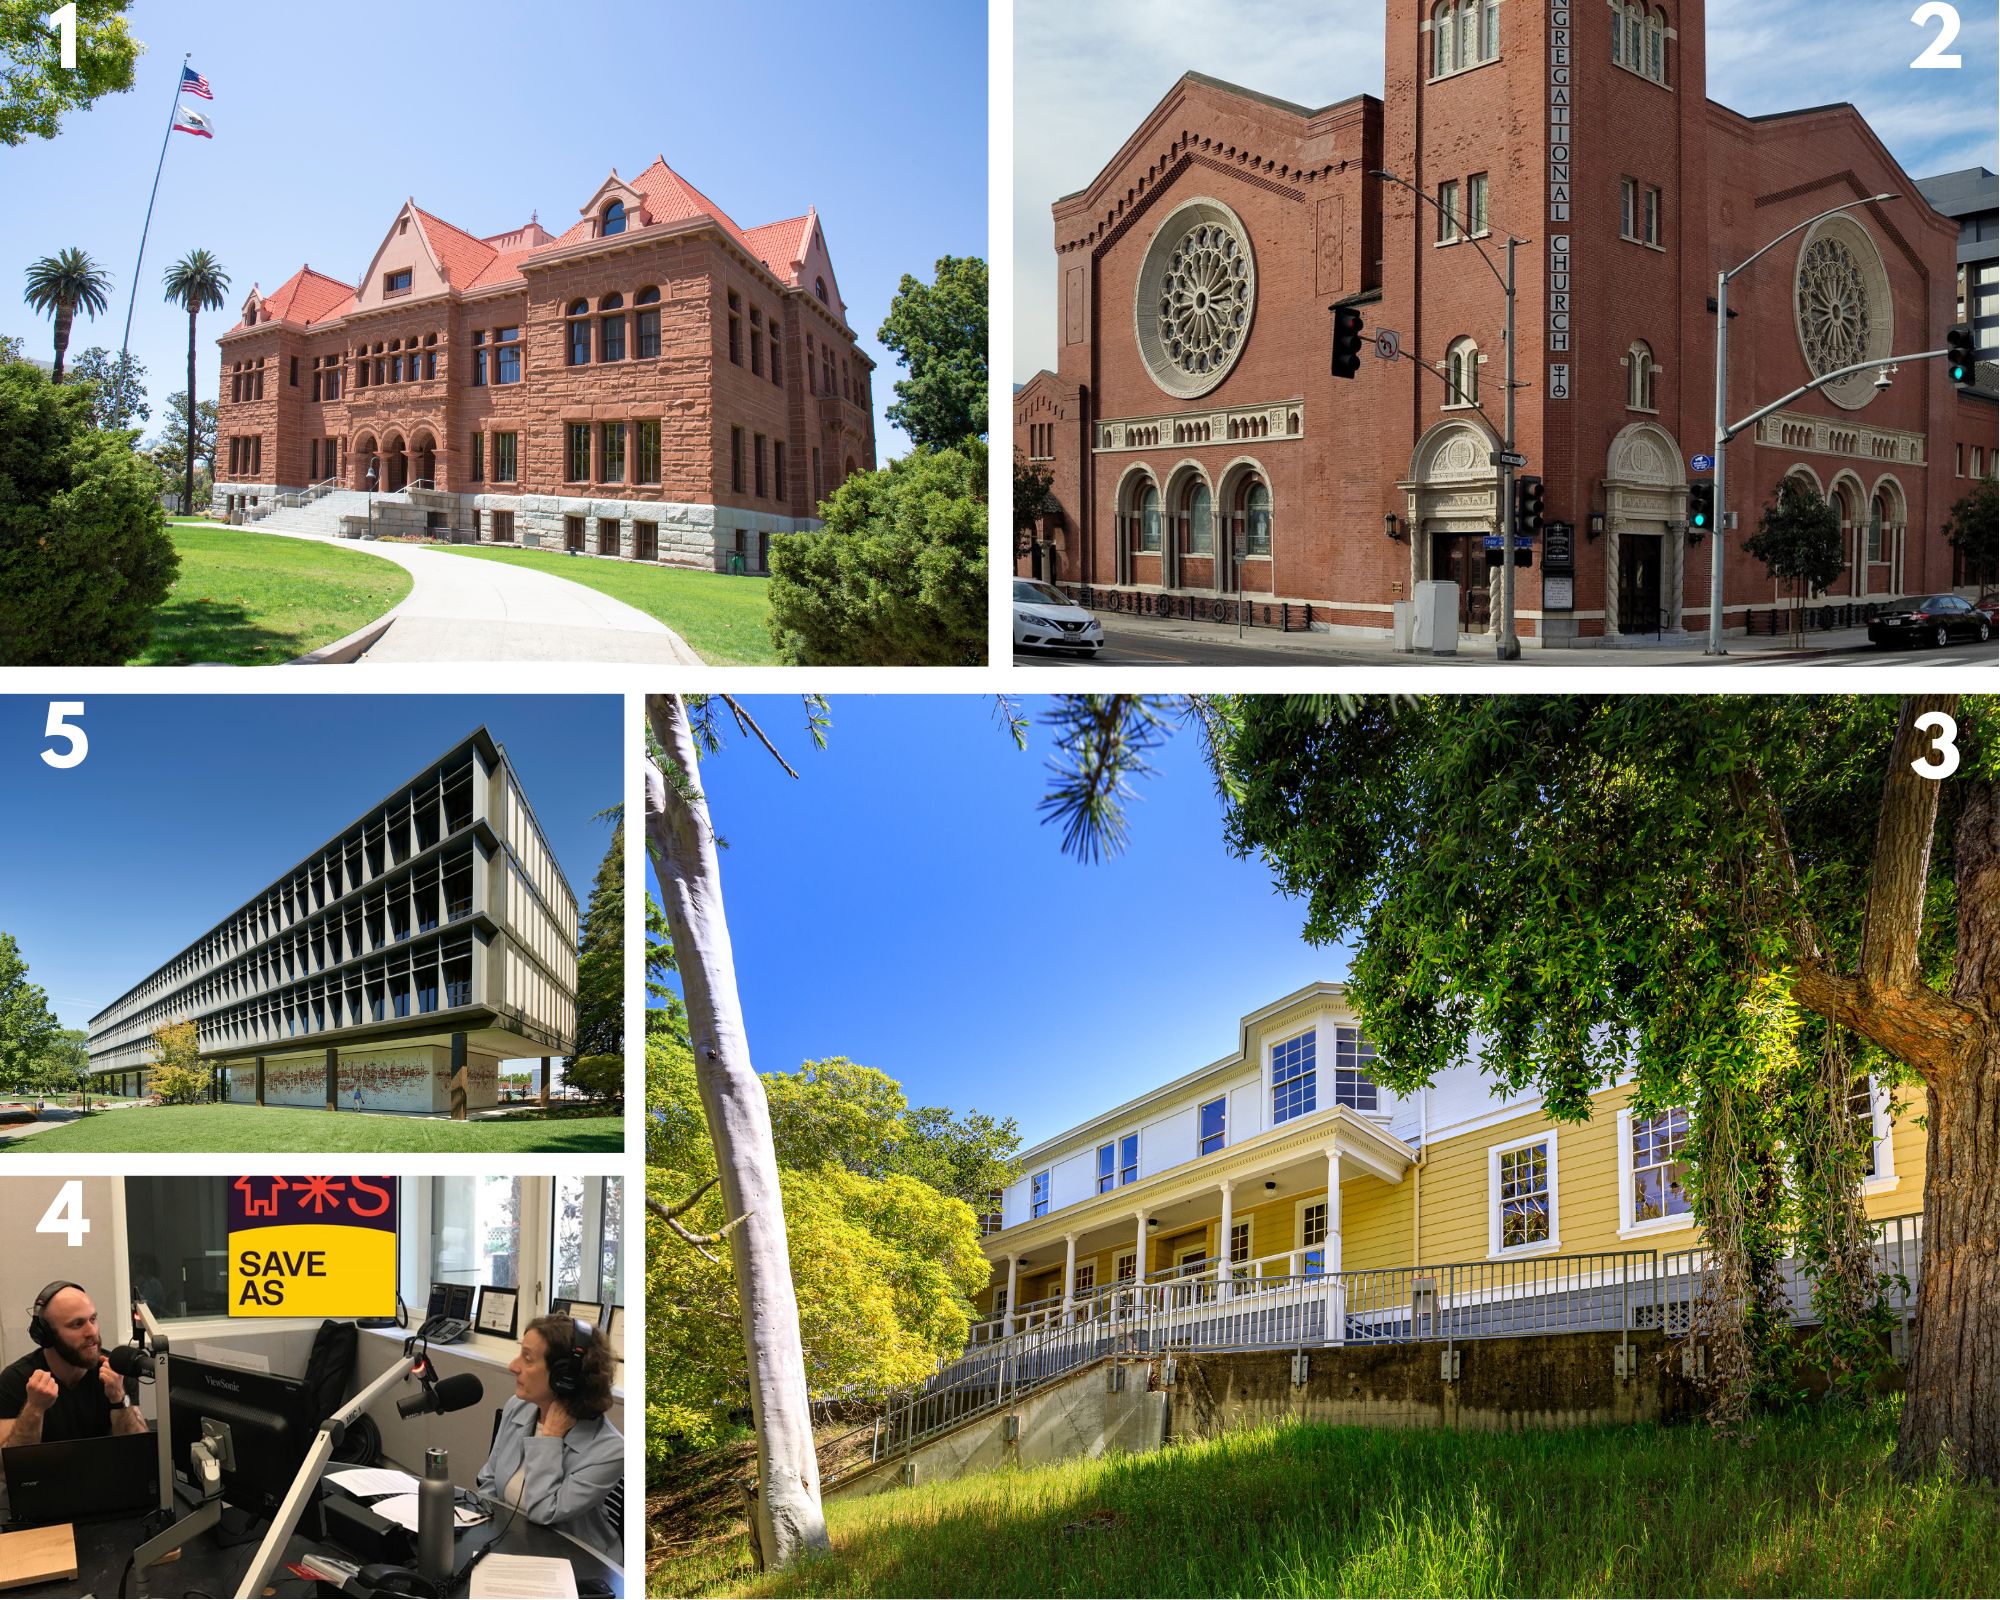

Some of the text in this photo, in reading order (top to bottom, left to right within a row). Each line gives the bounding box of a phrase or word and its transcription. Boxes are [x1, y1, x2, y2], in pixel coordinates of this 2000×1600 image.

[1552, 236, 1568, 350] CHURCH
[238, 1250, 327, 1277] SAVE
[238, 1279, 285, 1306] AS
[159, 1356, 166, 1365] 2
[205, 1375, 240, 1393] ViewSonic
[345, 1409, 358, 1425] MIC
[320, 1433, 326, 1442] 1
